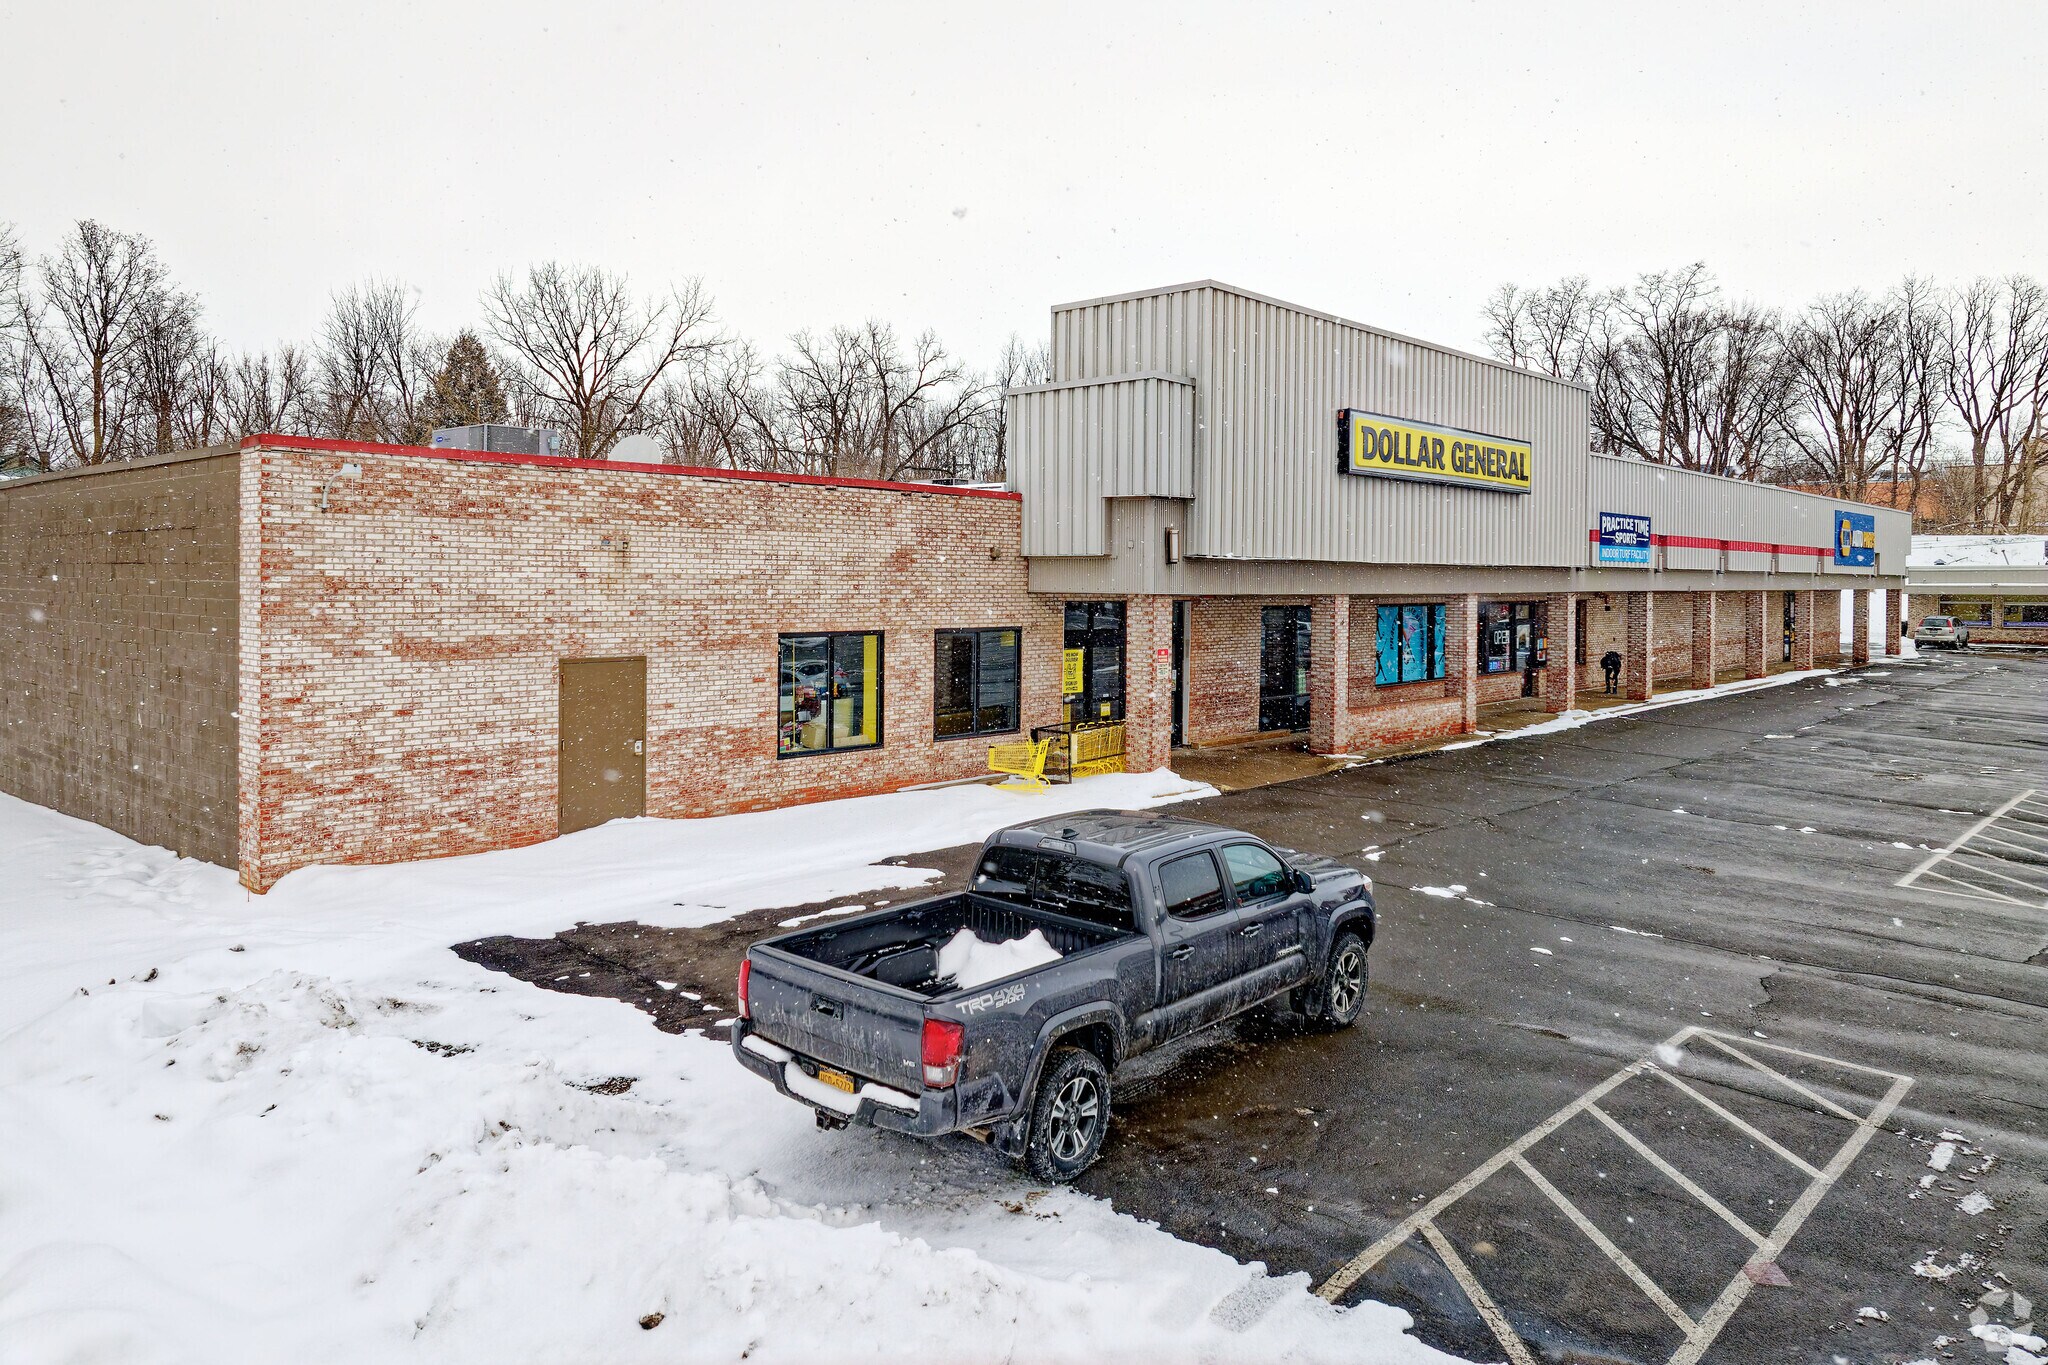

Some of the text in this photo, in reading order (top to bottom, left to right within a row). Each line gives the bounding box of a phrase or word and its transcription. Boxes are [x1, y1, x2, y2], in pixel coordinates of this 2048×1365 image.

[1361, 426, 1529, 482] DOLLAR GENERAL
[1602, 516, 1650, 537] PRACTICE TIME
[1615, 531, 1637, 545] SPORTS
[1601, 548, 1649, 560] INDOOR TURF FACILITY
[955, 993, 995, 1015] TRD
[996, 992, 1026, 1009] SPORT
[902, 1058, 916, 1068] V6
